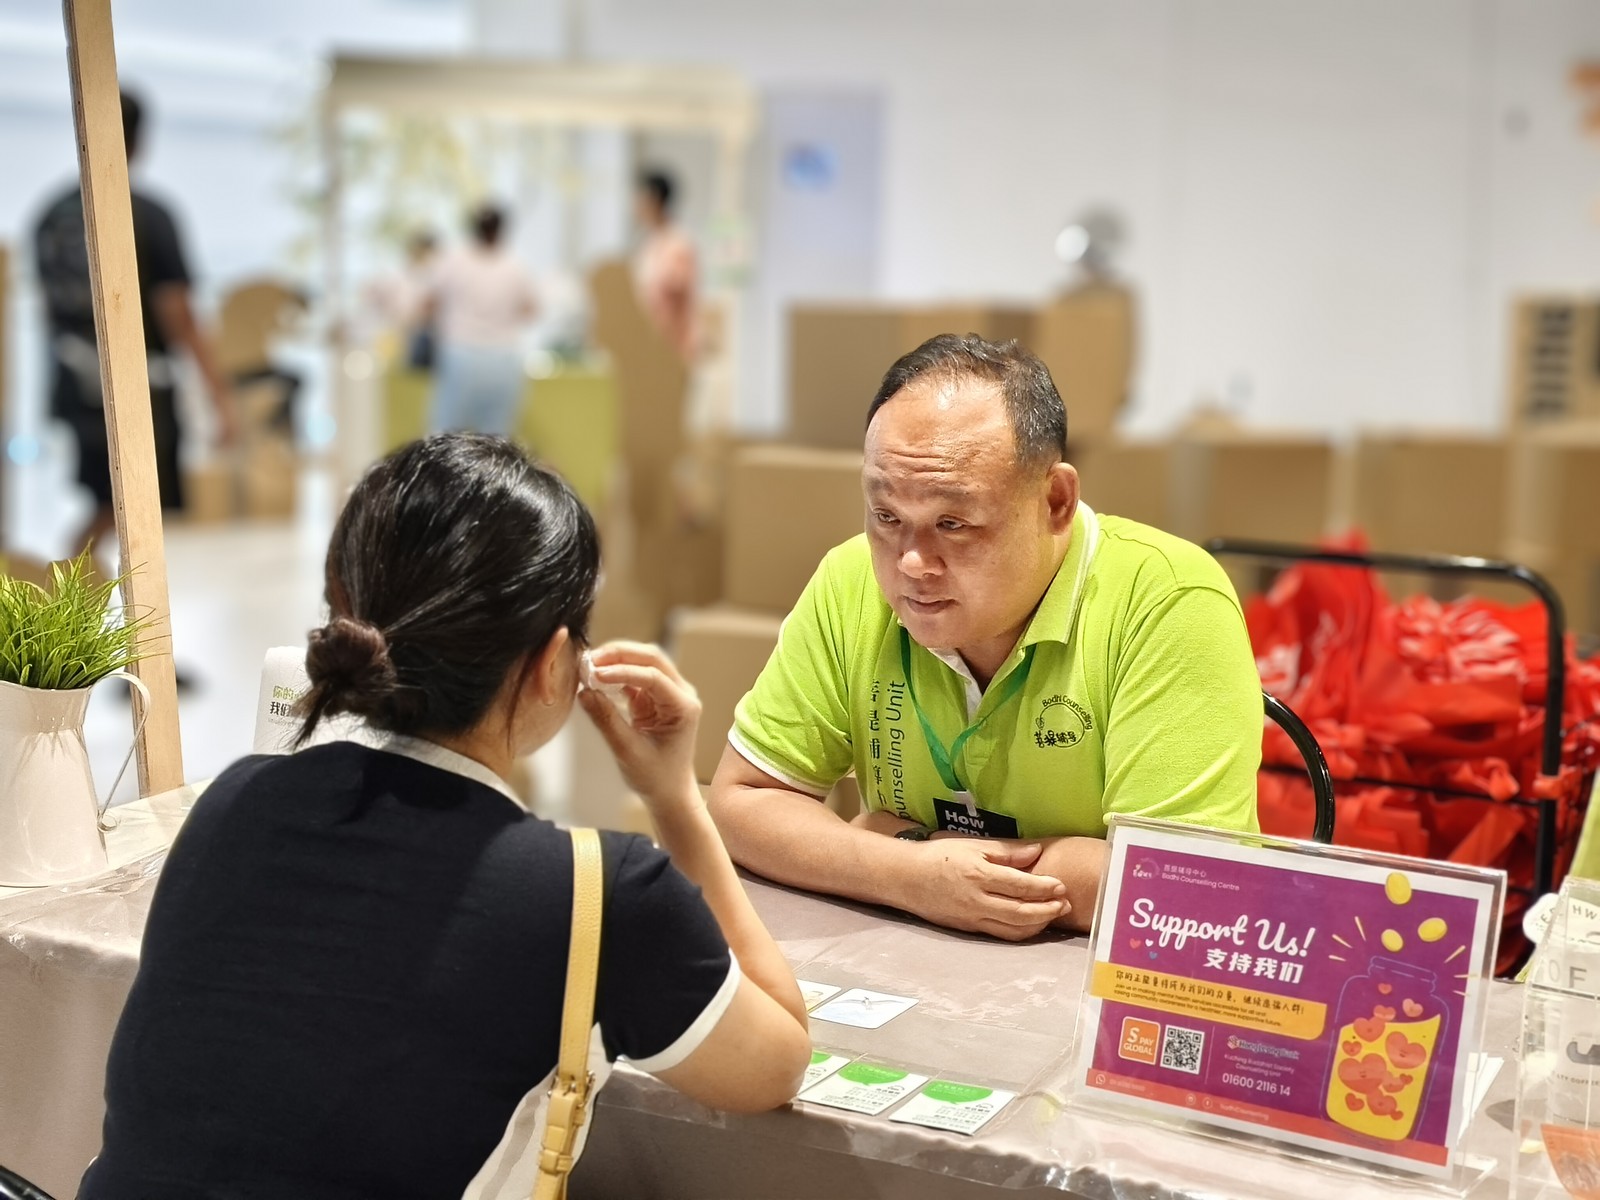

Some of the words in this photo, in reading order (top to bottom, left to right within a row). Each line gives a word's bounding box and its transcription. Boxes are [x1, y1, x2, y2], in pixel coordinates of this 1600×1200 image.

[886, 680, 905, 721] Unit
[1063, 695, 1093, 730] Counselling
[888, 727, 911, 819] ounselling
[945, 810, 984, 829] How
[1162, 872, 1179, 881] Bodhi
[1180, 875, 1217, 888] Counselling
[1217, 881, 1240, 891] Centre
[1129, 898, 1248, 950] Support
[1254, 919, 1316, 958] Us!
[1203, 948, 1303, 984] 支持我们
[1137, 988, 1156, 996] making
[1123, 1042, 1153, 1056] GLOBAL
[1127, 1027, 1140, 1043] S
[1139, 1036, 1154, 1046] PAY
[1222, 1072, 1254, 1088] 01600
[1256, 1079, 1277, 1094] 2116
[1280, 1085, 1291, 1097] 14
